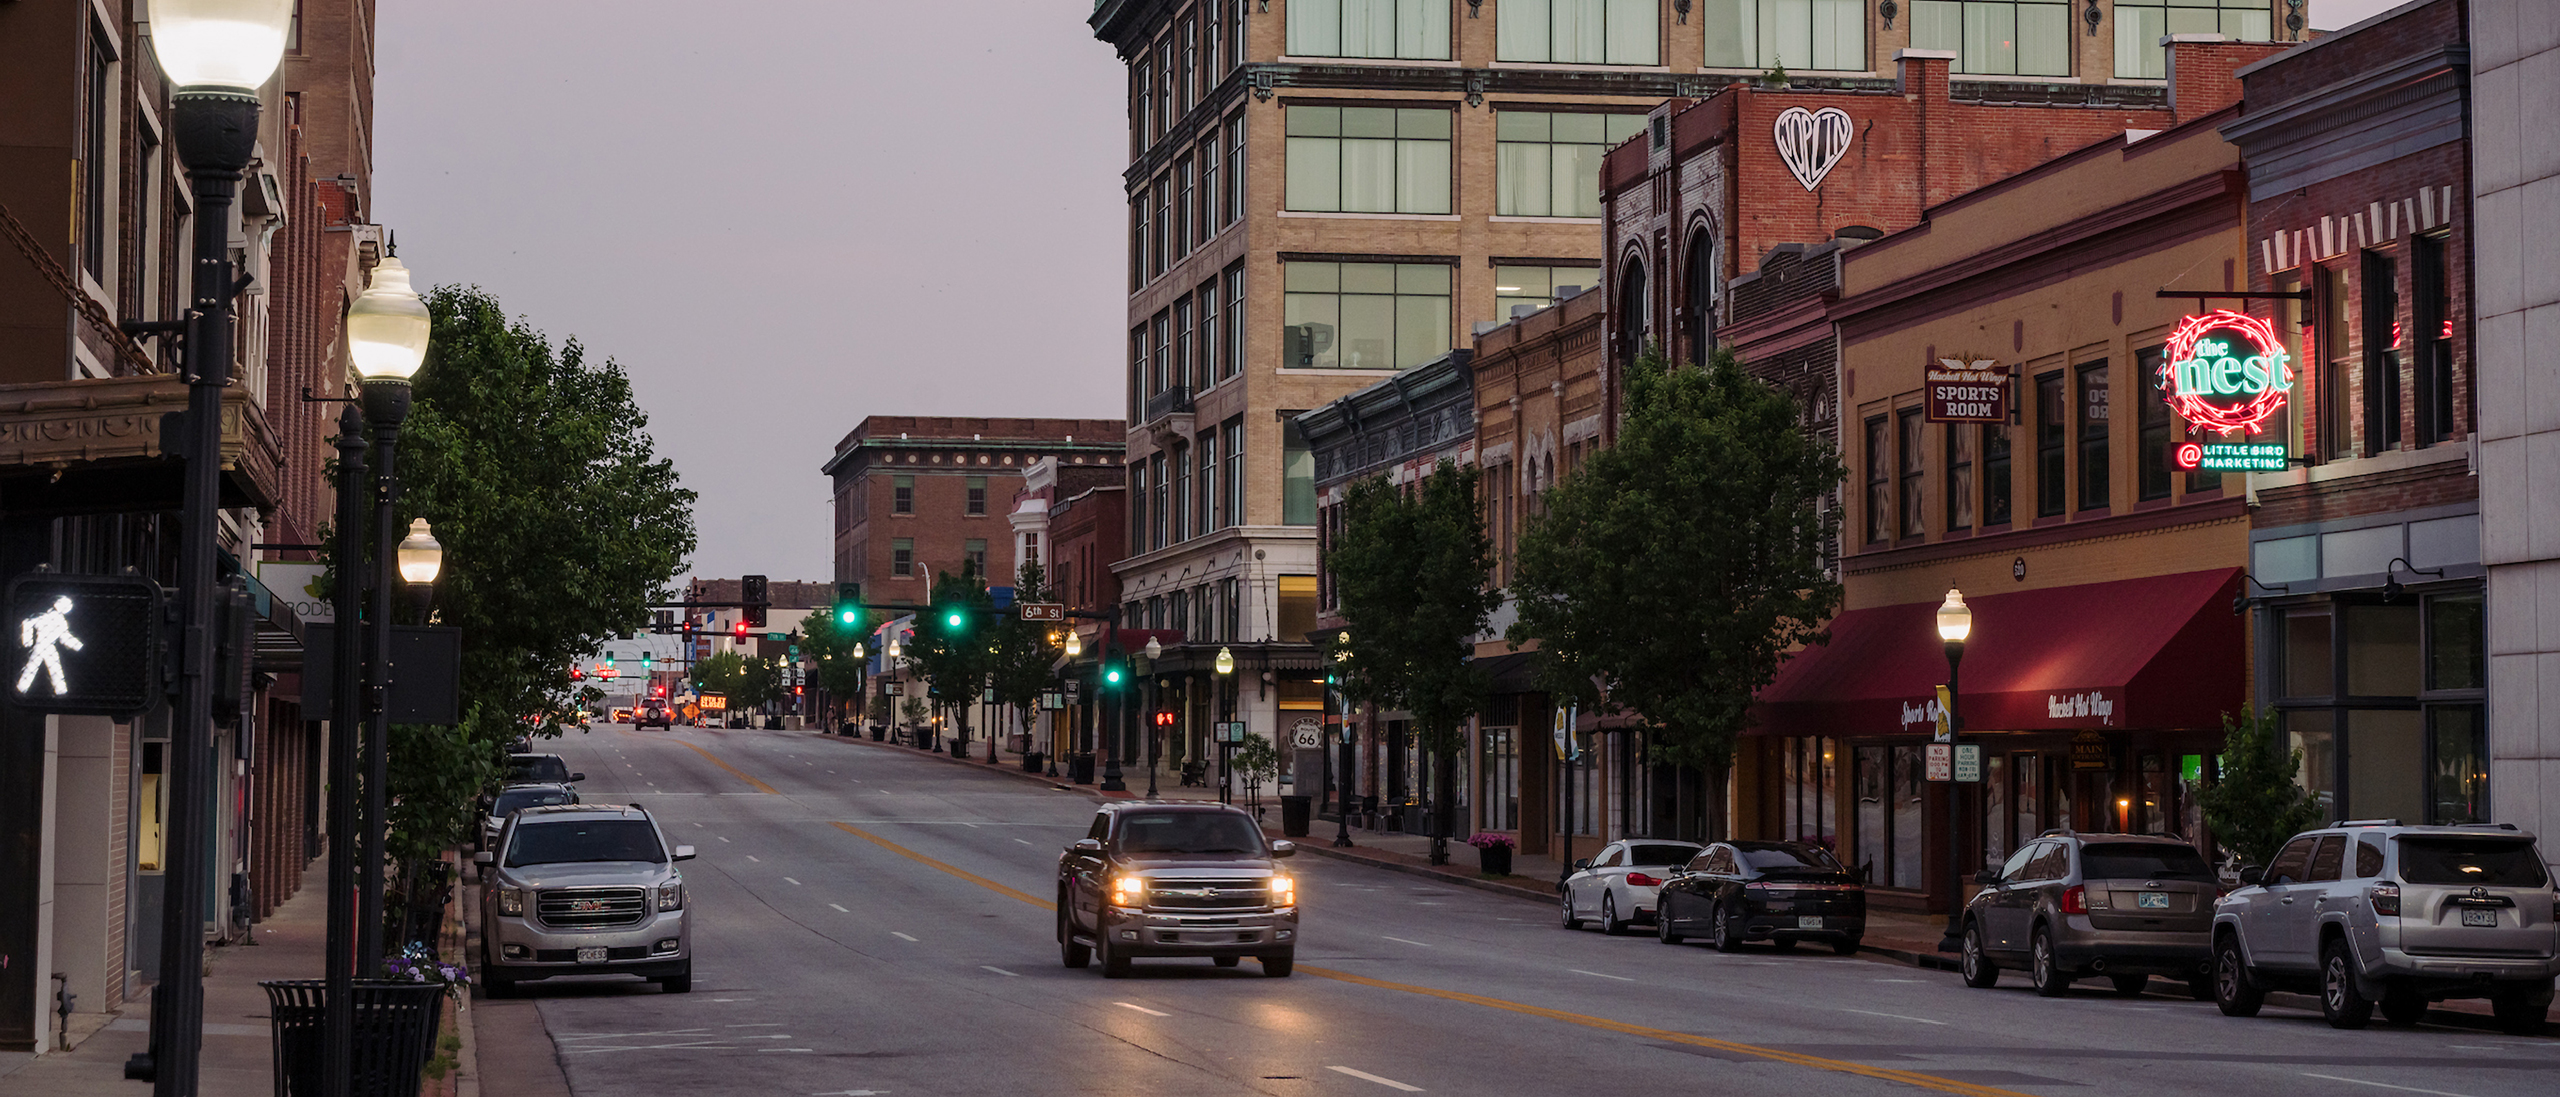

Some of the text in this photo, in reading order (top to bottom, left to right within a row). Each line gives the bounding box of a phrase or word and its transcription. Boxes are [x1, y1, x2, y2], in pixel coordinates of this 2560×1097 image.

[1780, 112, 1849, 184] JOPLIN
[2195, 338, 2229, 357] the
[1927, 370, 2008, 386] Hackett Hot Wings
[2174, 347, 2294, 395] nest
[1936, 386, 1999, 401] SPORTS
[1946, 402, 1992, 417] ROOM
[2177, 444, 2202, 468] @
[2203, 445, 2284, 456] LITTLE BIRD
[2202, 457, 2285, 469] MARKETING
[1025, 606, 1059, 618] 6th St
[2048, 690, 2113, 725] Hackett Hot Wings
[1901, 701, 1924, 731] Sports
[1298, 733, 1316, 746] 66
[2075, 745, 2103, 754] MAIN
[571, 900, 611, 911] GMC
